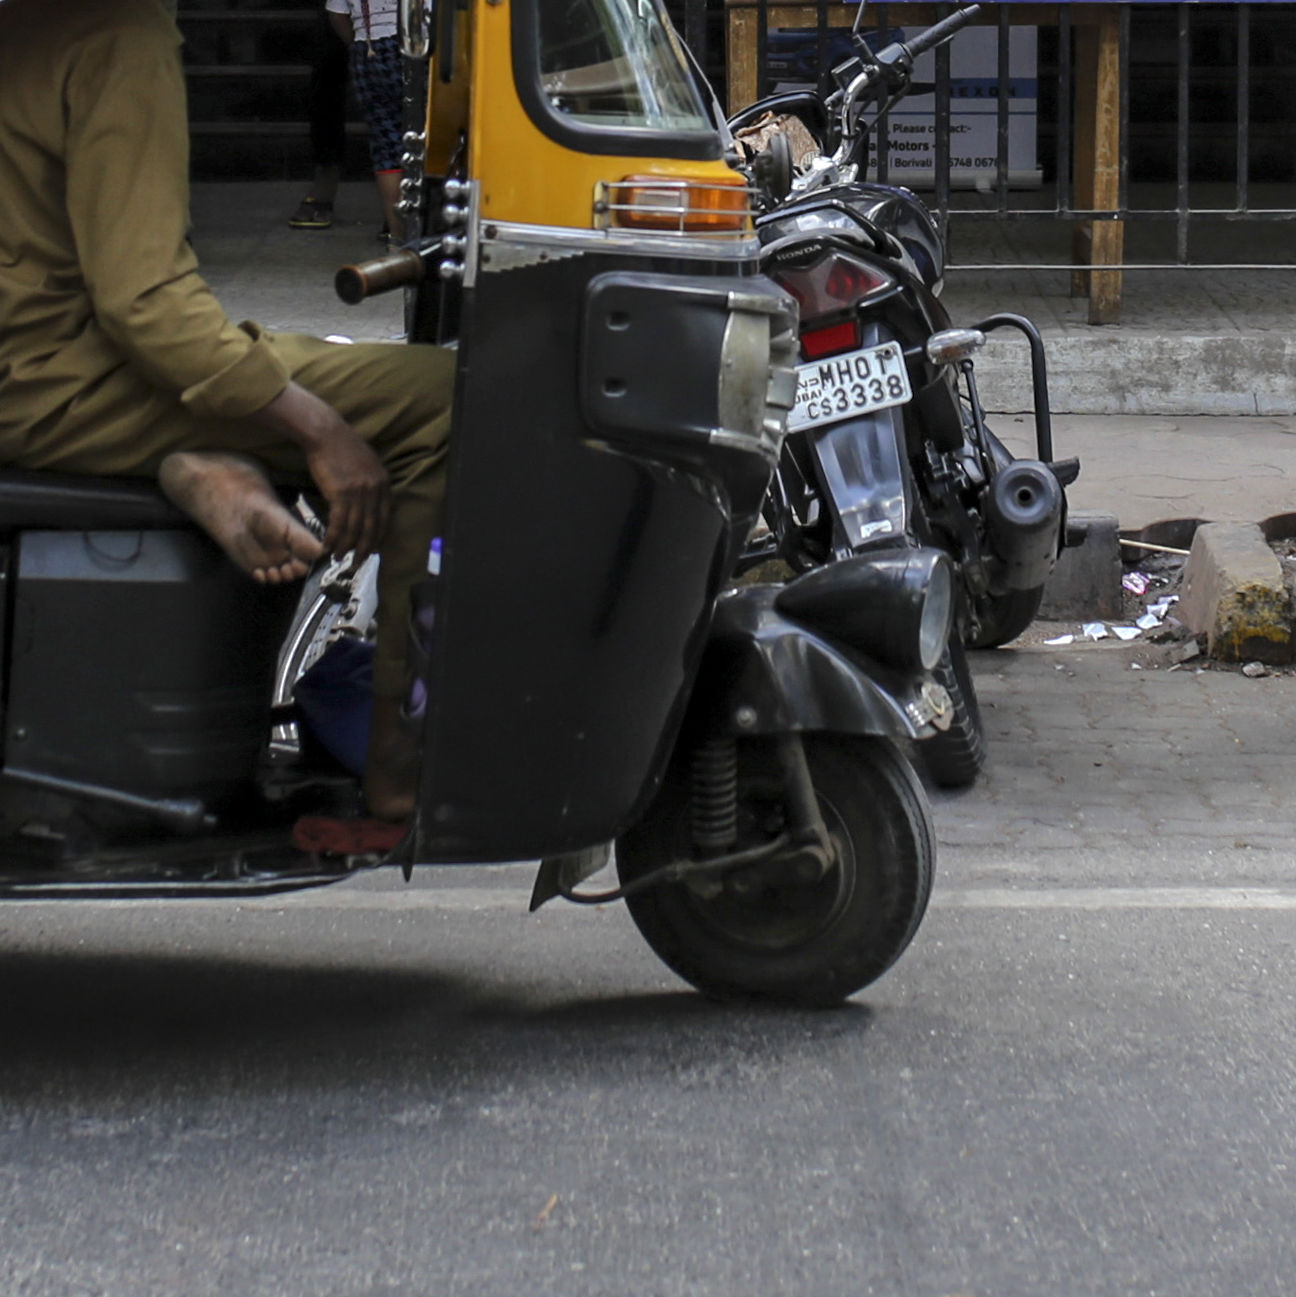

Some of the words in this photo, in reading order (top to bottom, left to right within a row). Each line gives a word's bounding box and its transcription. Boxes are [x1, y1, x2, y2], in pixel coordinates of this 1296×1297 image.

[892, 124, 926, 133] Please
[887, 141, 929, 151] Motors
[895, 158, 933, 168] Borivali
[777, 245, 822, 261] HONDA
